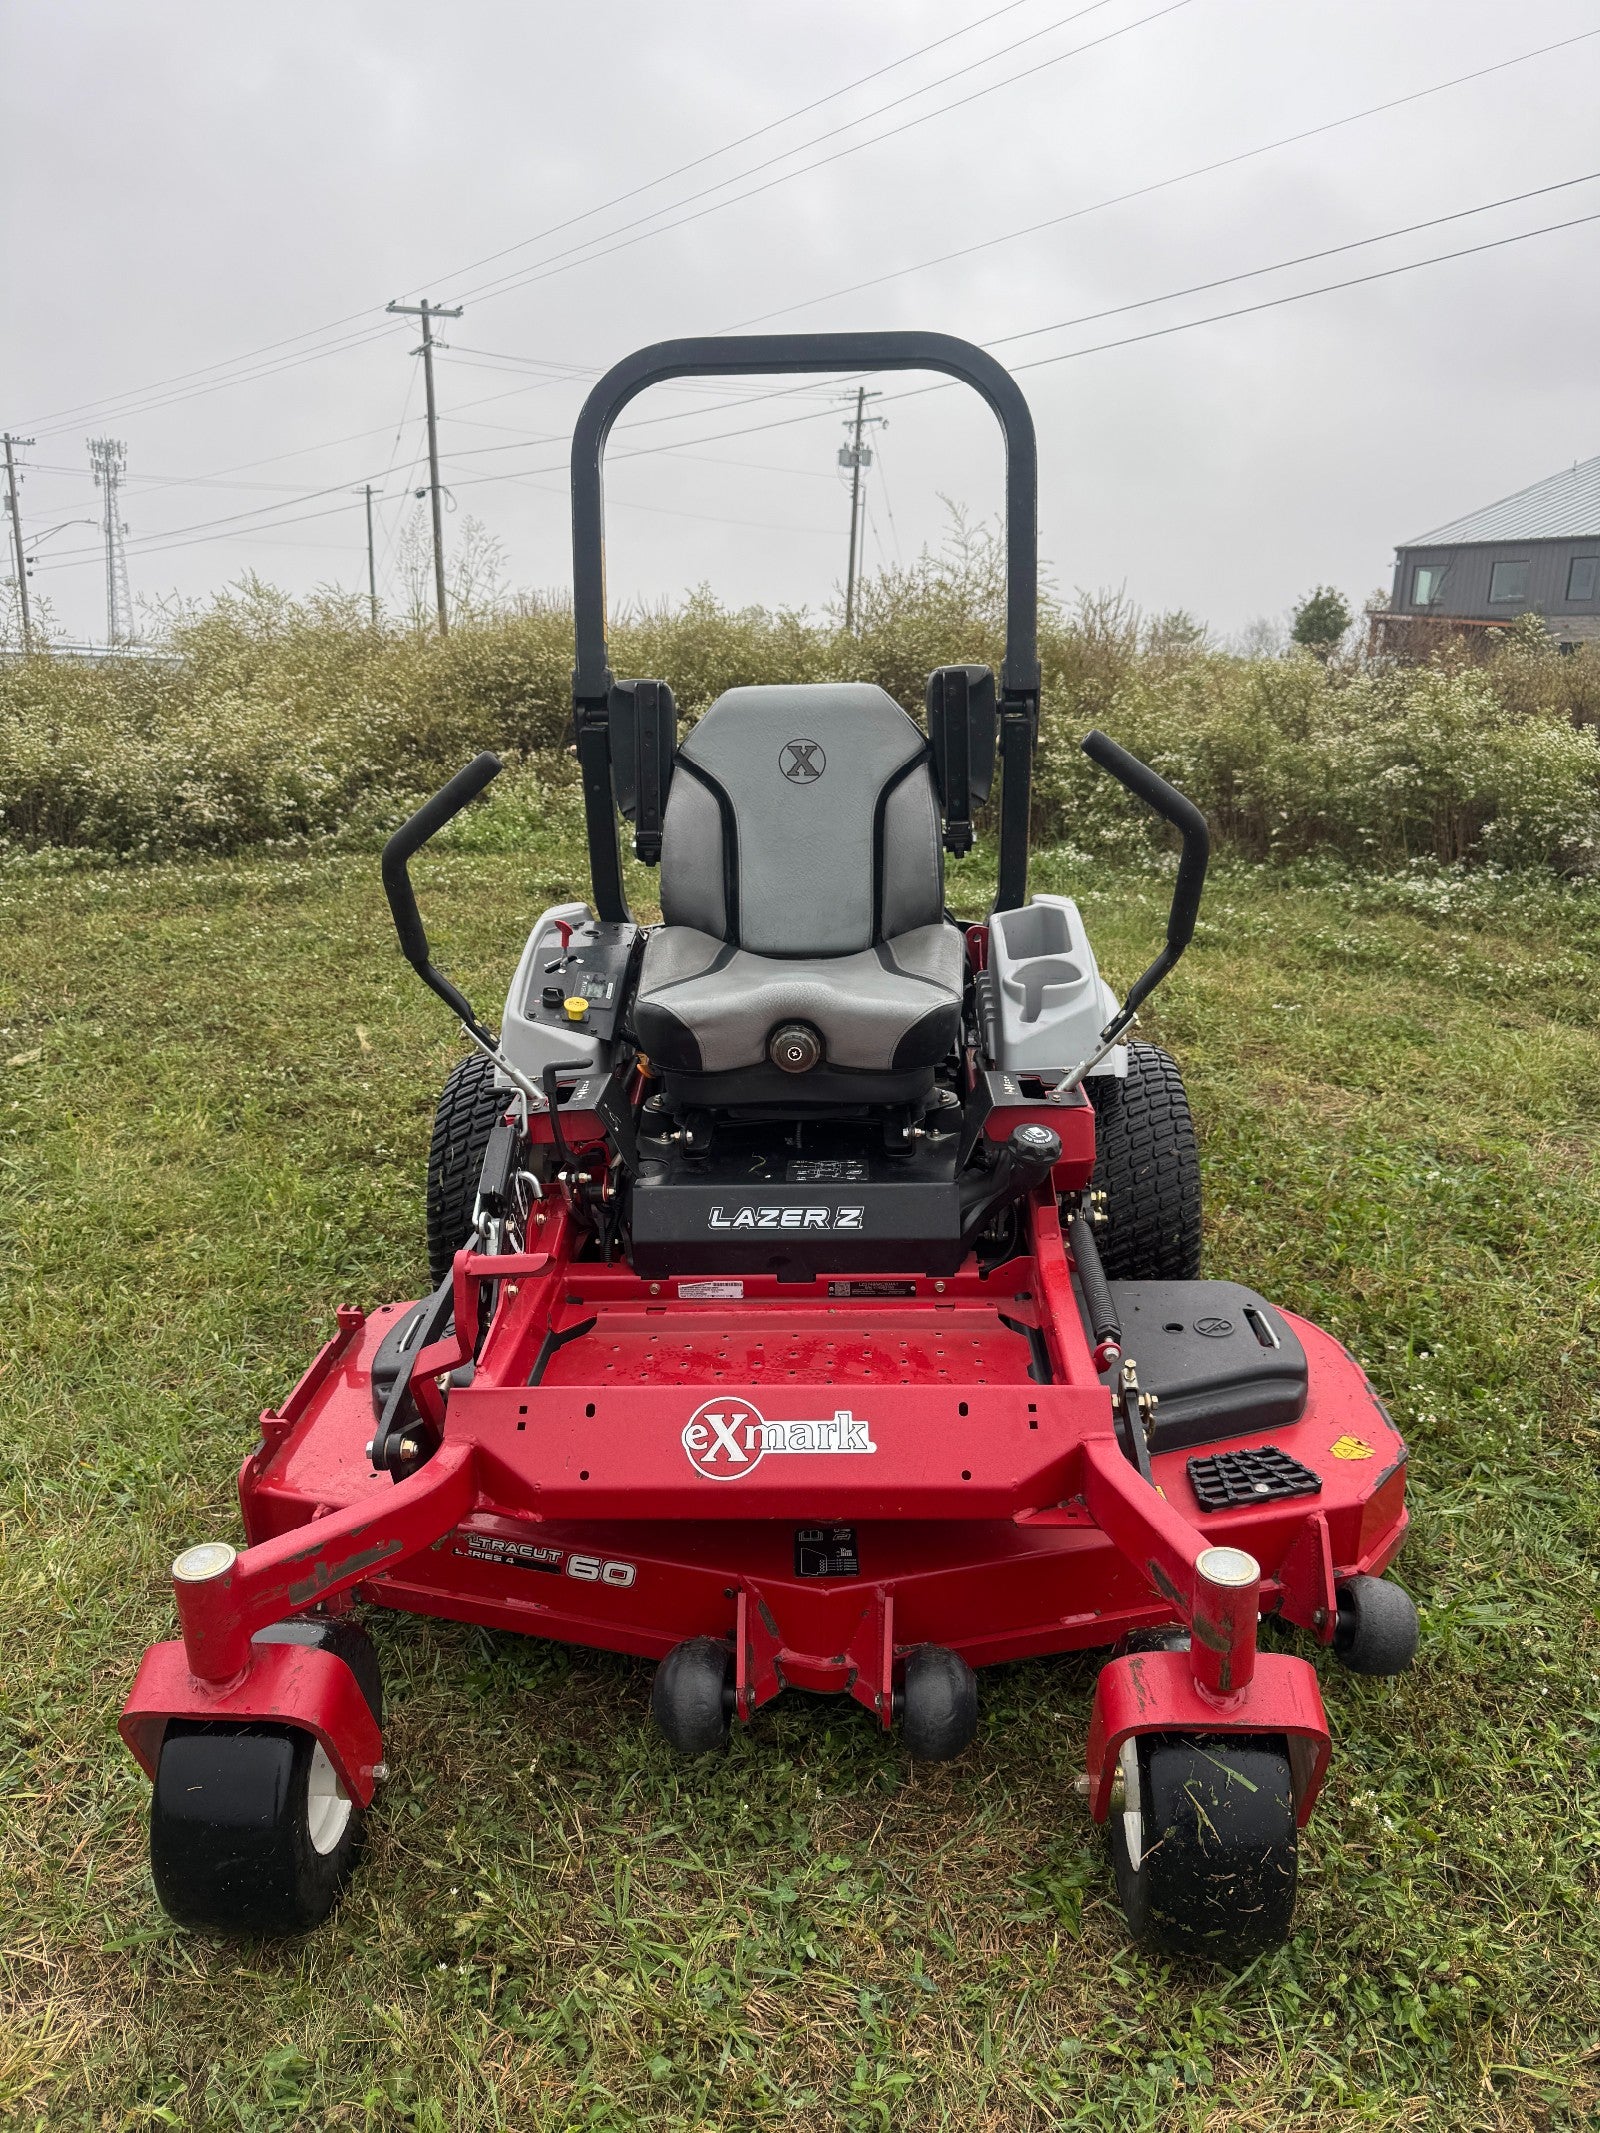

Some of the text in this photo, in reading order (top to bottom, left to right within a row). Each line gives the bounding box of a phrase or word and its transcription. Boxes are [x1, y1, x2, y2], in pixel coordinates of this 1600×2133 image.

[786, 745, 820, 777] X
[709, 1206, 864, 1230] LAZER Z
[465, 1534, 637, 1588] LTRACUT 60
[505, 1556, 516, 1565] 4
